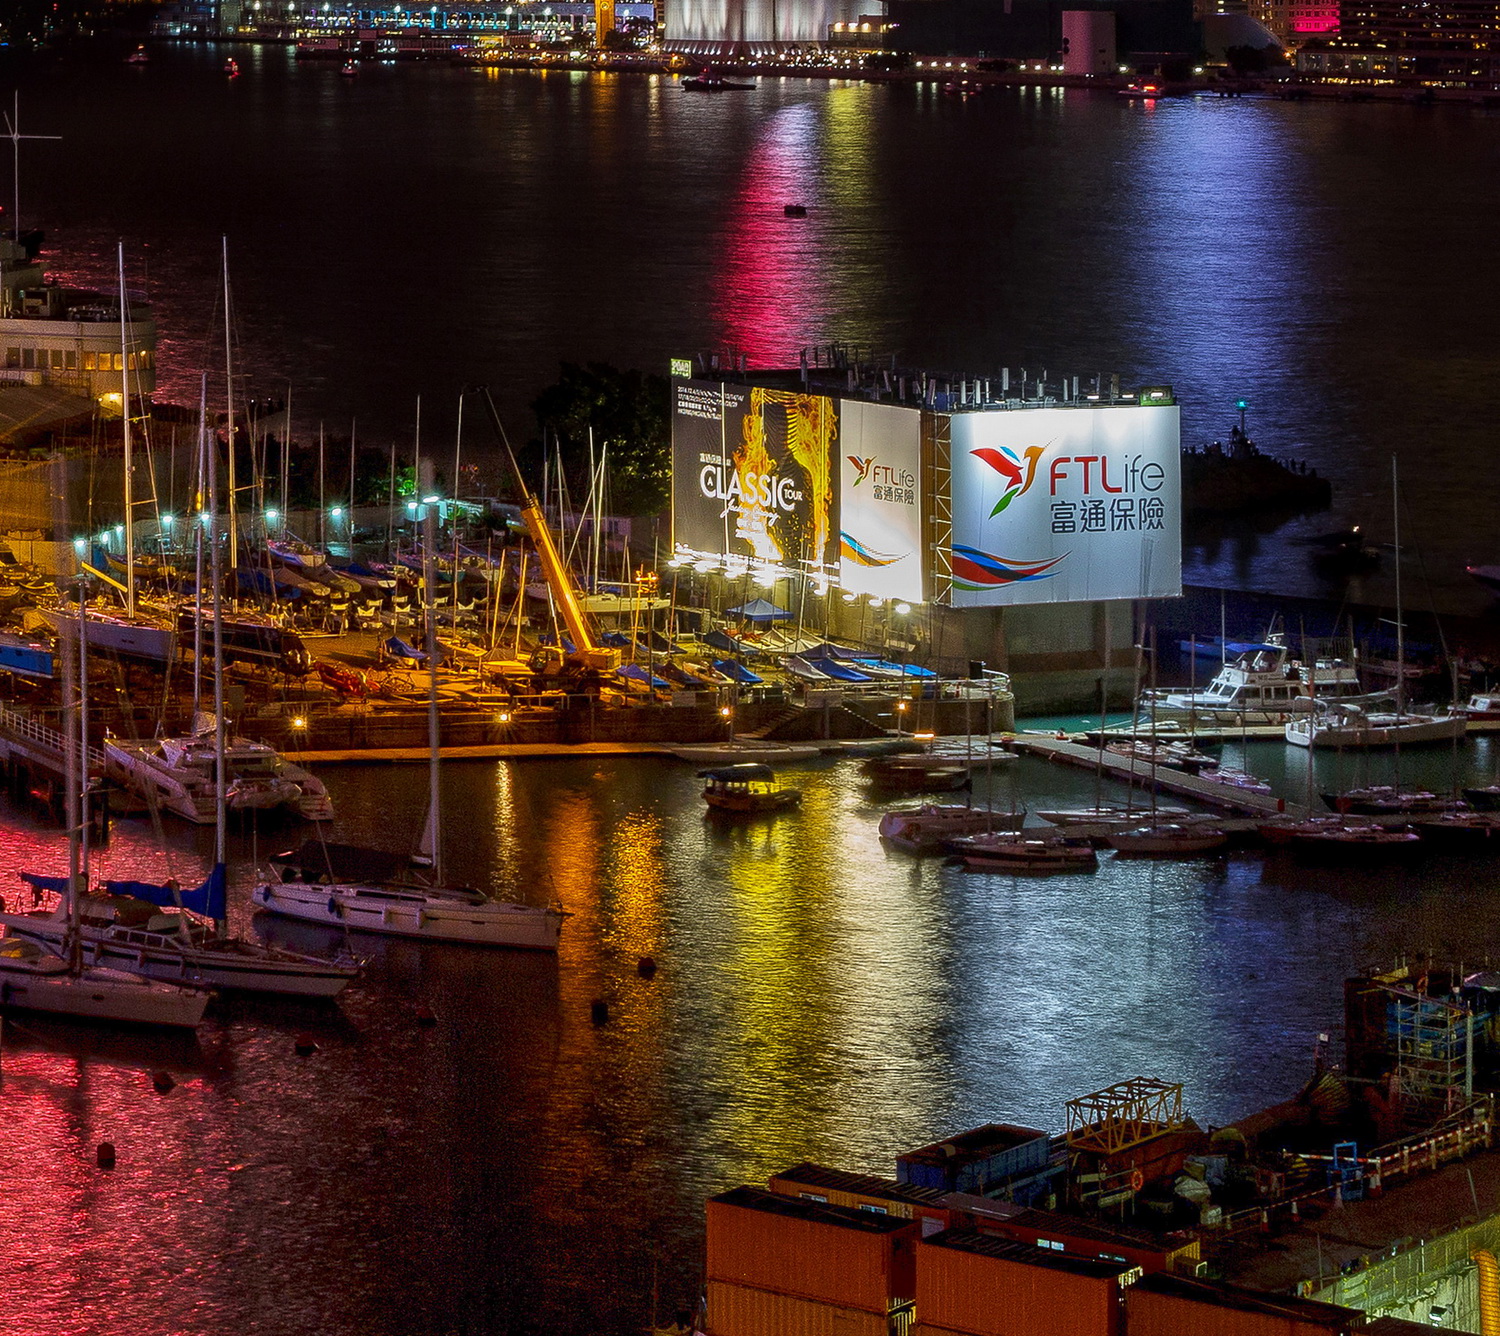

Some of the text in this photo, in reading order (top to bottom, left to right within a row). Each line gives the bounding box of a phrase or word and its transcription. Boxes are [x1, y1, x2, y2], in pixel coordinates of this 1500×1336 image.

[700, 464, 796, 511] CLASSIC
[784, 489, 803, 501] TOUR
[873, 465, 915, 488] FTLife
[1050, 454, 1165, 496] FTLife
[873, 485, 914, 505] 富通保險
[1051, 497, 1165, 534] 富通保險
